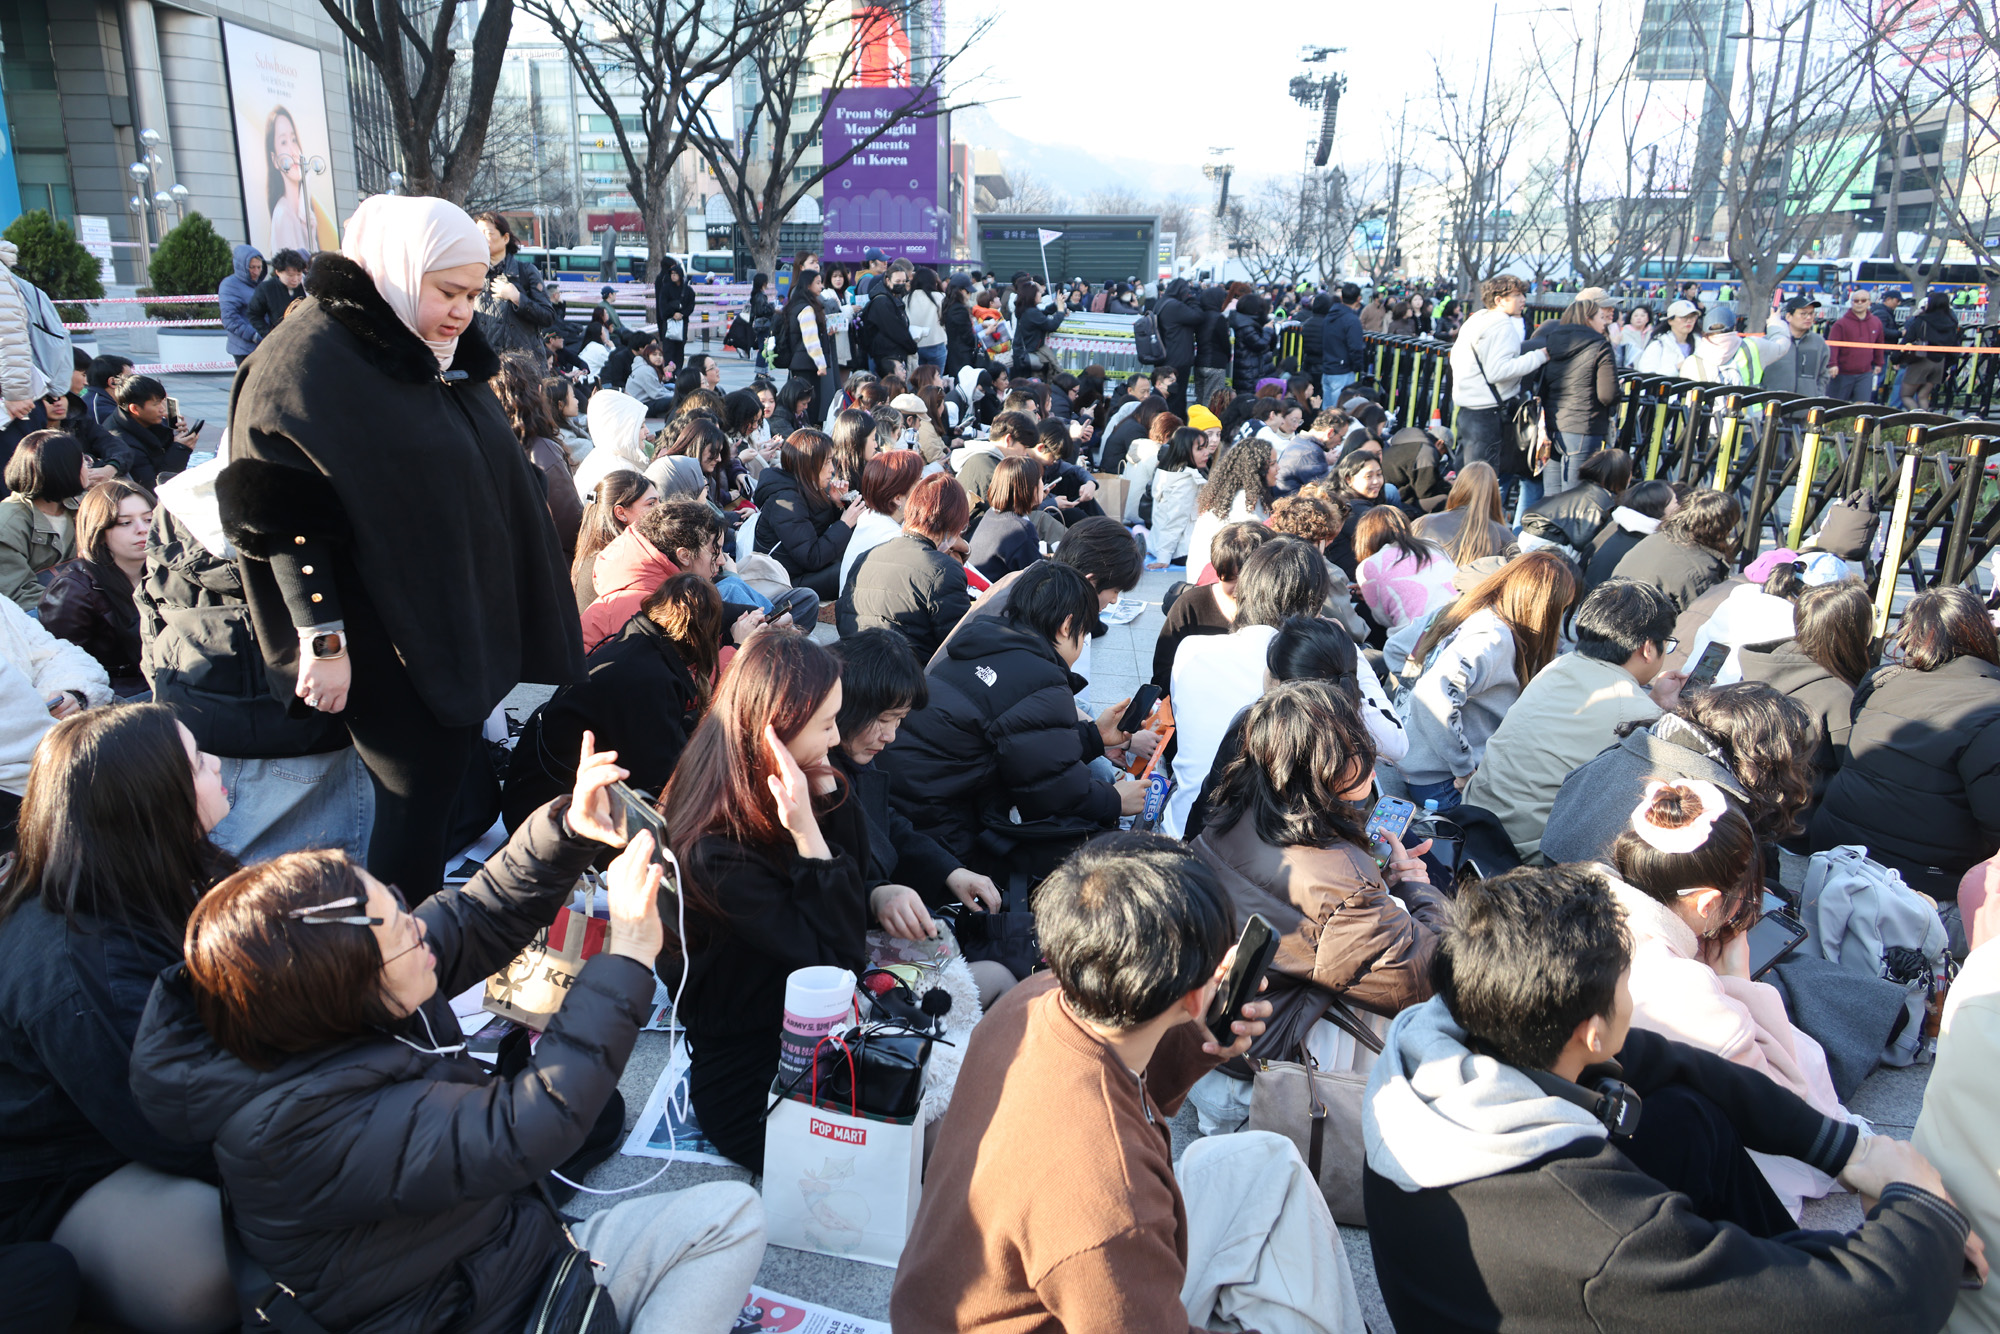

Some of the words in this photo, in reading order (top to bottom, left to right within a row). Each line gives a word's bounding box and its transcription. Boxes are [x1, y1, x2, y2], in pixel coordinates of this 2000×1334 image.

[255, 52, 298, 78] Sulwhasoo
[836, 107, 872, 119] From
[853, 153, 866, 165] in
[869, 153, 908, 165] Korea
[1146, 779, 1162, 820] OREO
[543, 967, 576, 990] KF
[786, 1018, 815, 1031] ARMY도
[812, 1120, 832, 1137] POP
[833, 1126, 864, 1143] MART
